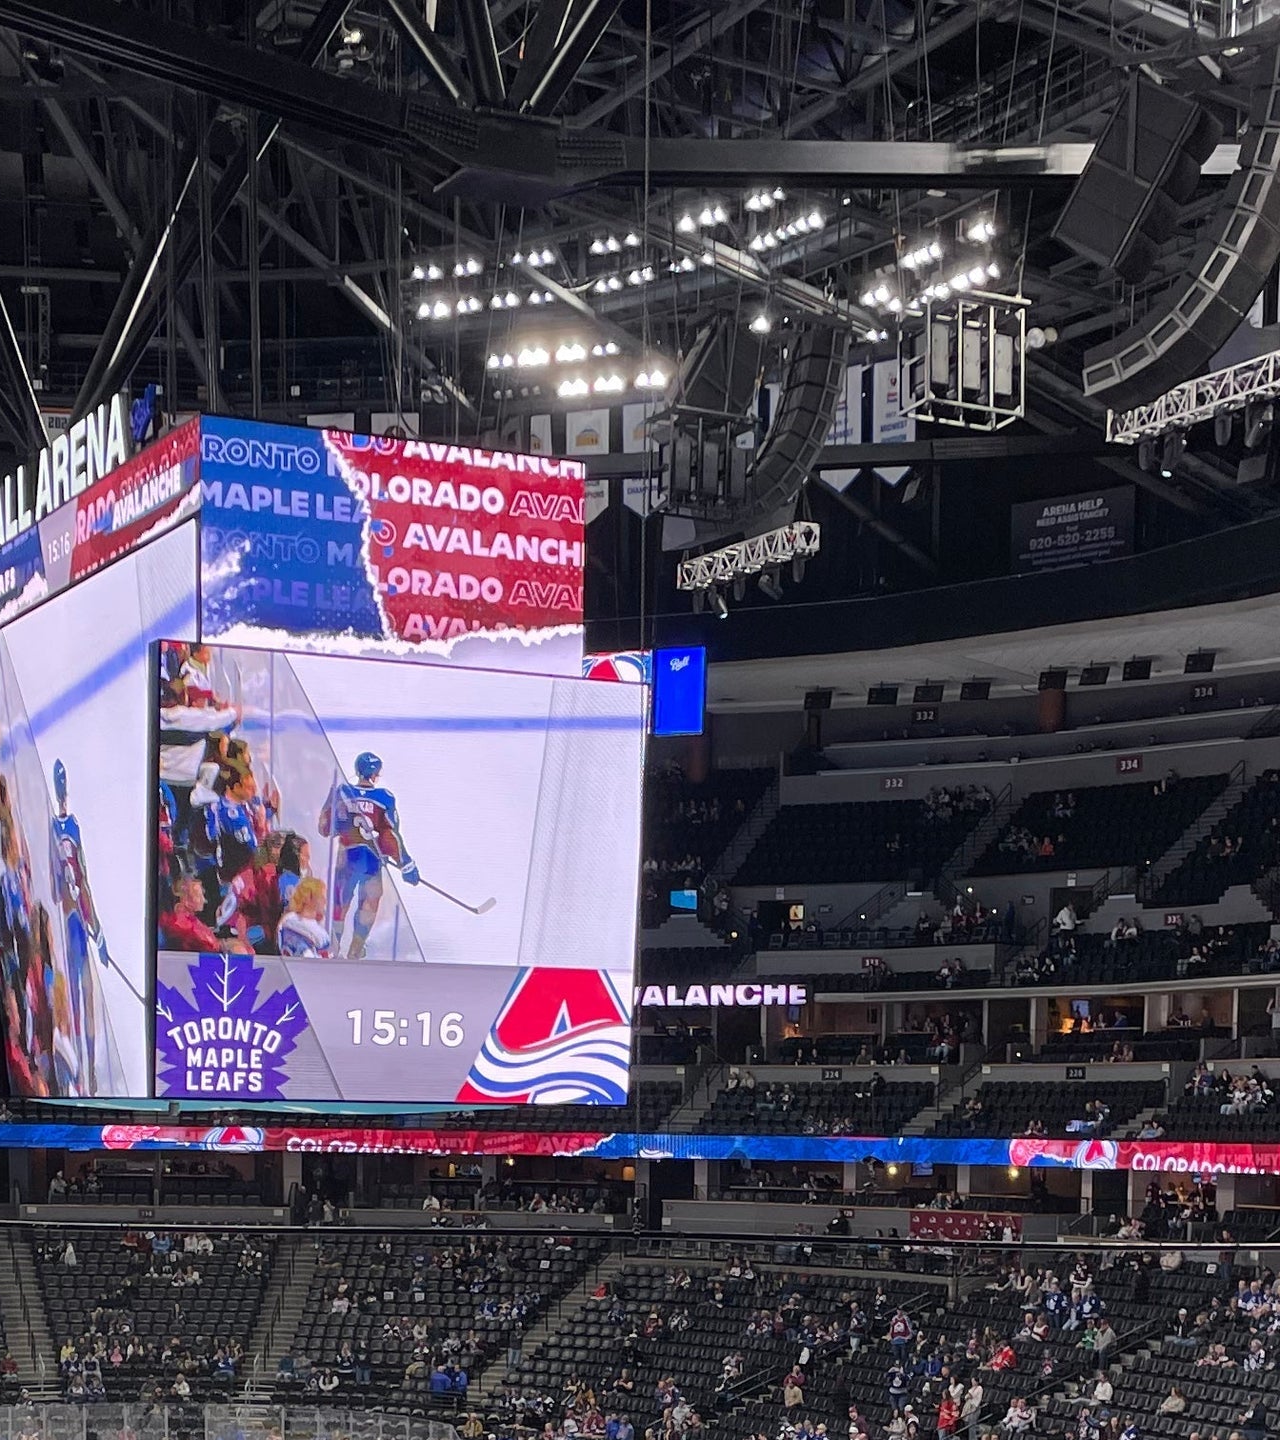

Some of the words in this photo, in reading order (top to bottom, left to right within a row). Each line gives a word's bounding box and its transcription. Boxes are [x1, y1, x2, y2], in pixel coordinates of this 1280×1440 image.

[35, 392, 126, 522] ARENA
[111, 462, 181, 531] AVALANCHE
[201, 479, 310, 519] MAPLE
[1042, 502, 1076, 518] ARENA
[1077, 498, 1104, 511] HELP
[1036, 517, 1056, 528] NEED
[1056, 507, 1109, 525] ASSISTANCE?
[48, 531, 71, 565] 15:16
[1194, 687, 1213, 698] 334
[916, 711, 934, 721] 332
[1120, 759, 1138, 770] 334
[884, 779, 904, 789] 332
[634, 984, 807, 1007] ALANCHE
[166, 1017, 283, 1053] TORONTO
[345, 1009, 466, 1048] 15:16
[186, 1047, 264, 1070] MAPLE
[186, 1071, 263, 1093] LEAFS
